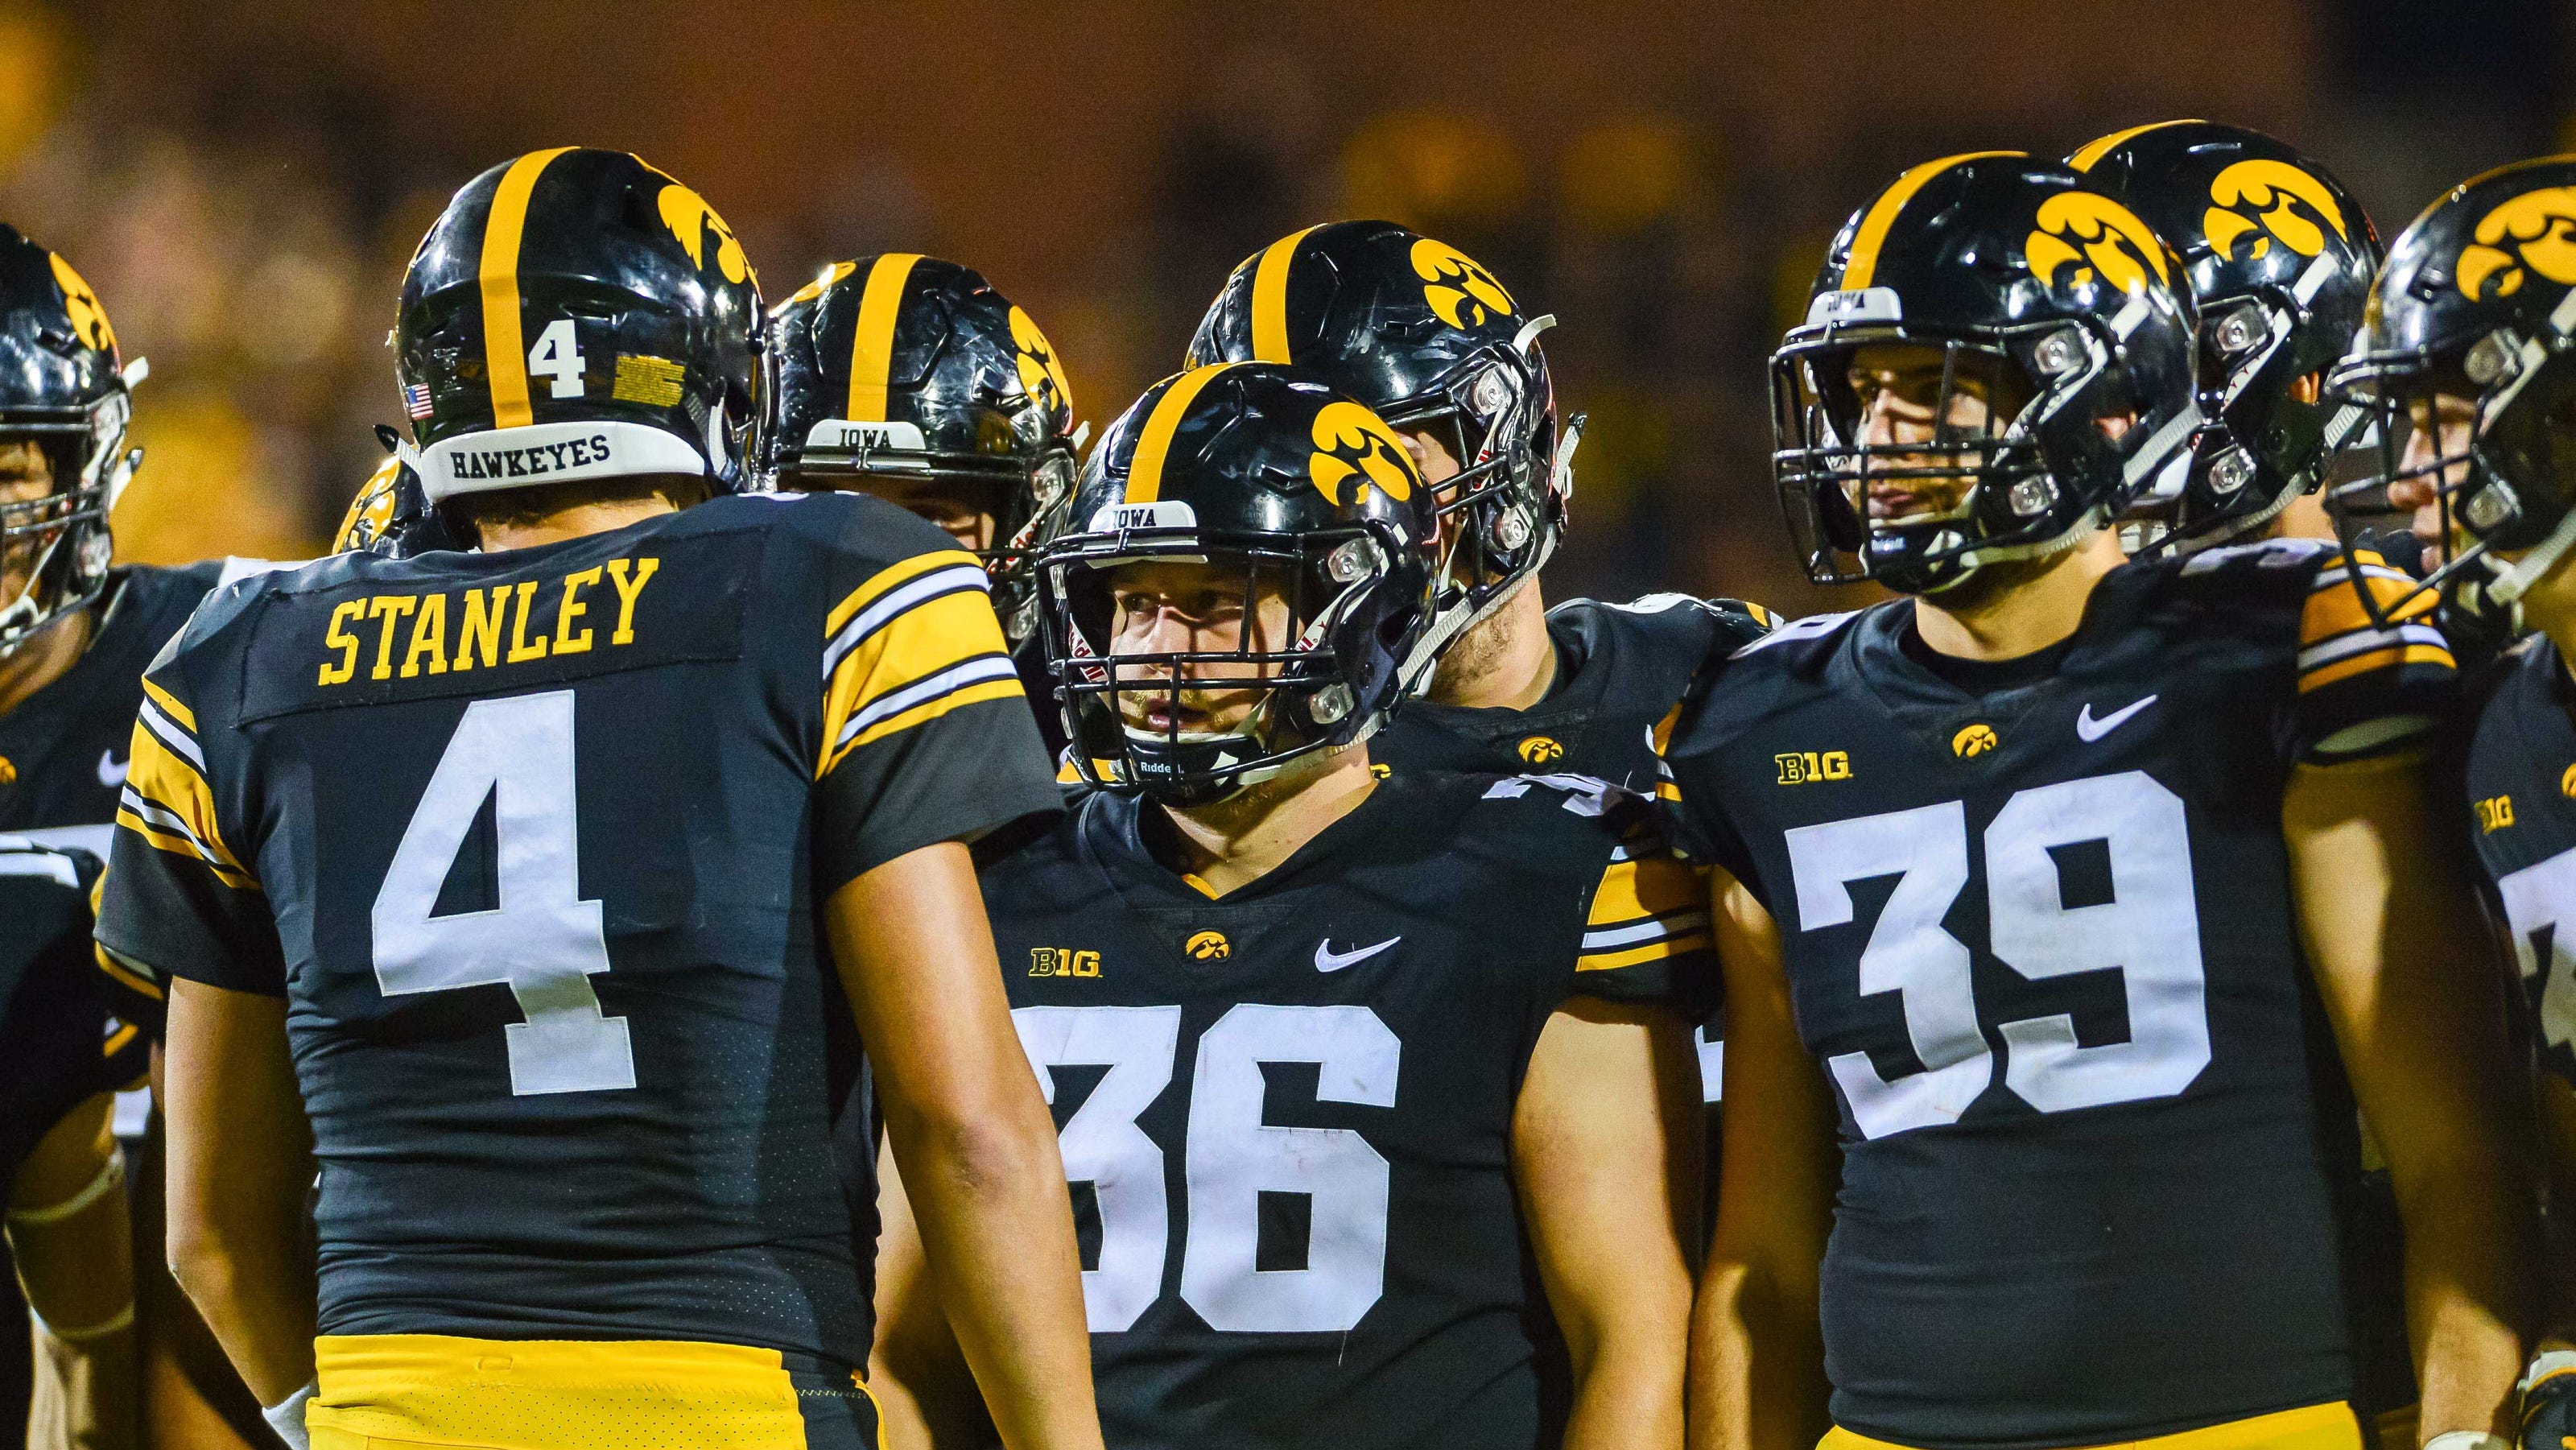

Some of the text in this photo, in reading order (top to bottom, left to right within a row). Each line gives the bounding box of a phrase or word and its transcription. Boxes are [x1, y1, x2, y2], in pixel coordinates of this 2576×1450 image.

[528, 319, 586, 399] 4
[450, 435, 610, 479] HAWKEYES
[840, 428, 892, 449] IOWA
[1113, 509, 1157, 528] IOWA
[318, 558, 659, 686] STANLEY
[1141, 762, 1181, 773] Riddel
[372, 689, 637, 1096] 4
[1784, 770, 2212, 1140] 39
[1009, 1003, 1402, 1332] 36
